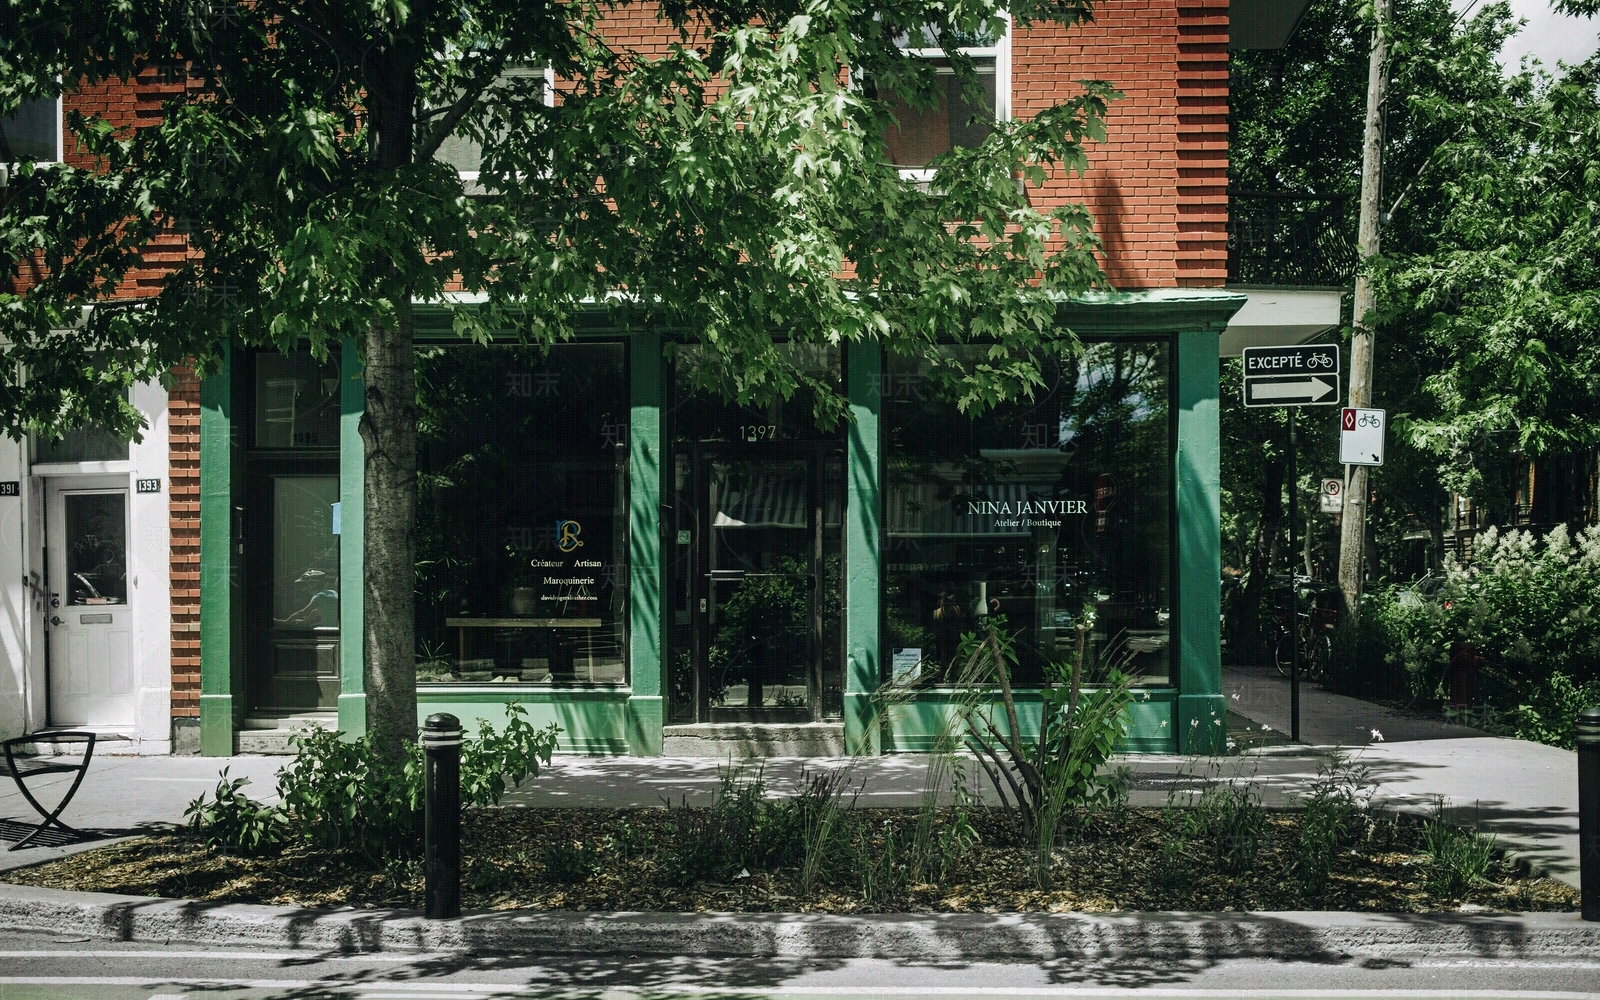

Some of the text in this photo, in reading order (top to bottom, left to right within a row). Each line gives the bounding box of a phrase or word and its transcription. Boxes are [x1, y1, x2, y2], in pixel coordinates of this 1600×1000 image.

[1249, 352, 1303, 369] EXCEPTÉ
[740, 425, 776, 440] 1397
[138, 480, 158, 491] 1393
[967, 500, 1088, 516] NINA JANVIER
[994, 519, 1020, 527] Atelier
[1027, 519, 1062, 528] Boutique
[531, 559, 602, 567] Créateur Artisan
[543, 576, 595, 586] Maroquinerie
